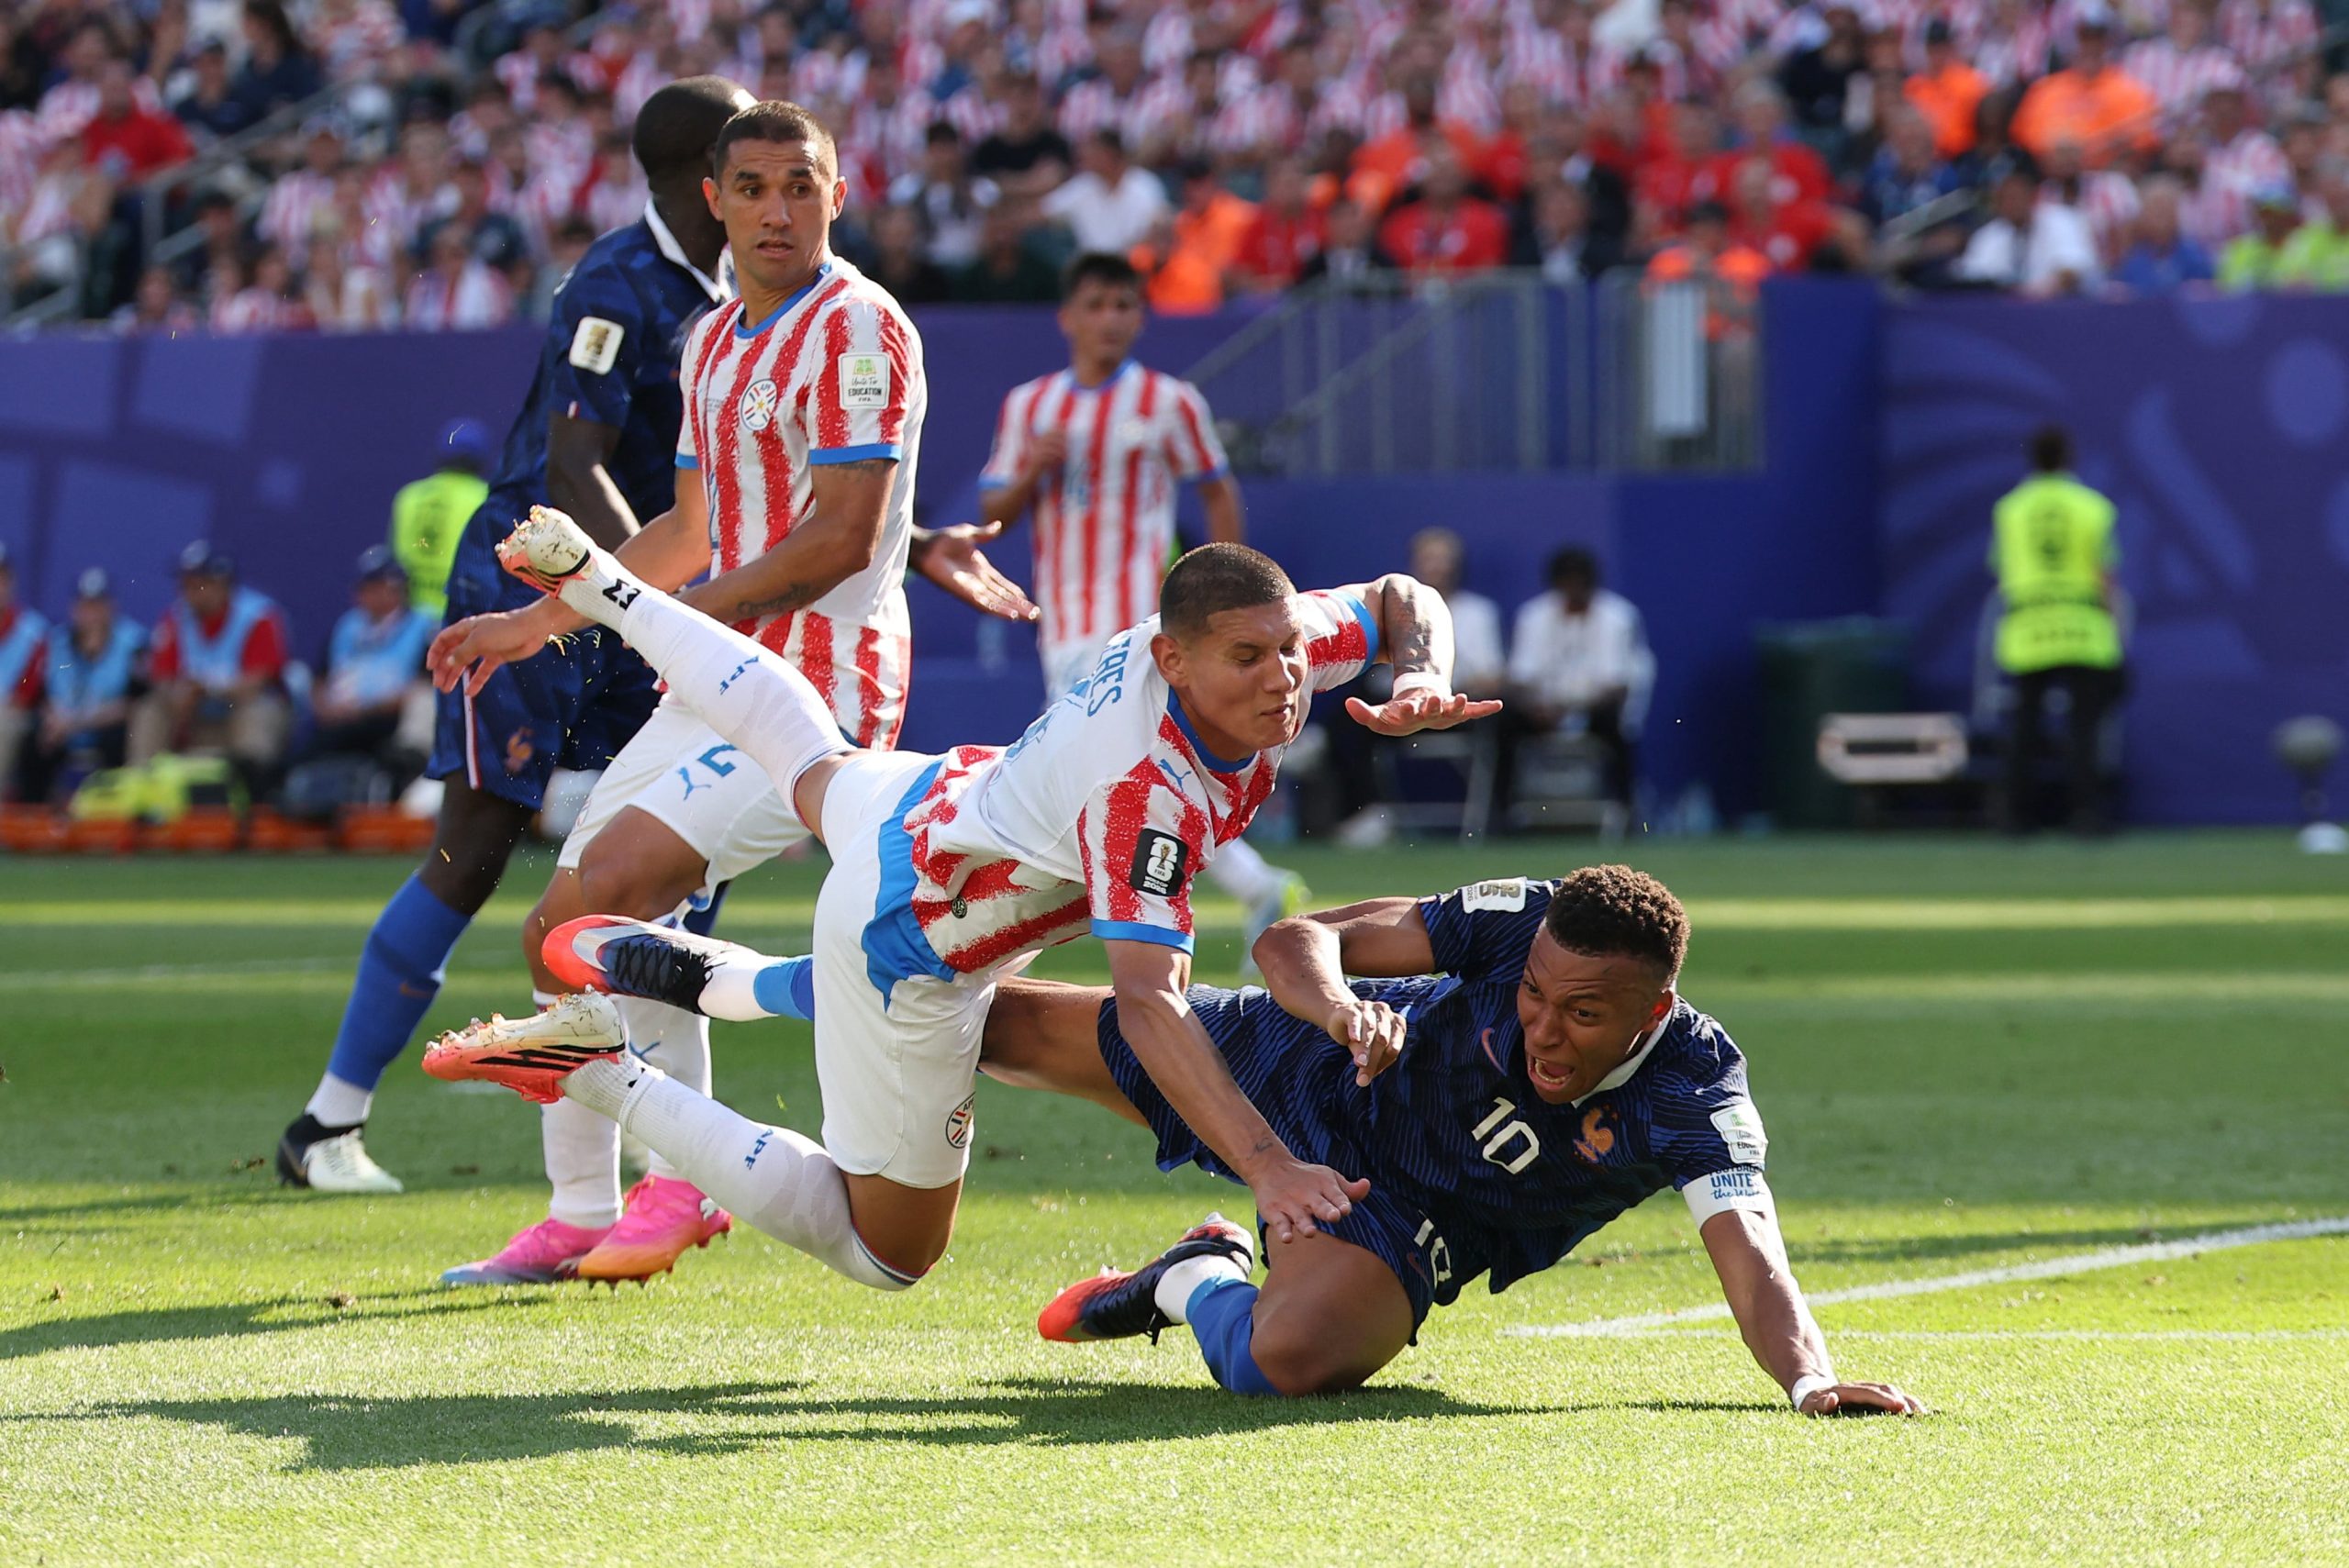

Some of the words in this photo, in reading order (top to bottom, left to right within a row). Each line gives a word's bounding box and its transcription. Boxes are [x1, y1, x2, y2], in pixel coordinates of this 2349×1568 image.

[848, 387, 882, 396] EDUCATION
[1153, 868, 1166, 877] FIFA
[1142, 881, 1167, 895] 2026
[1471, 1096, 1540, 1175] 10
[744, 1129, 774, 1170] APF
